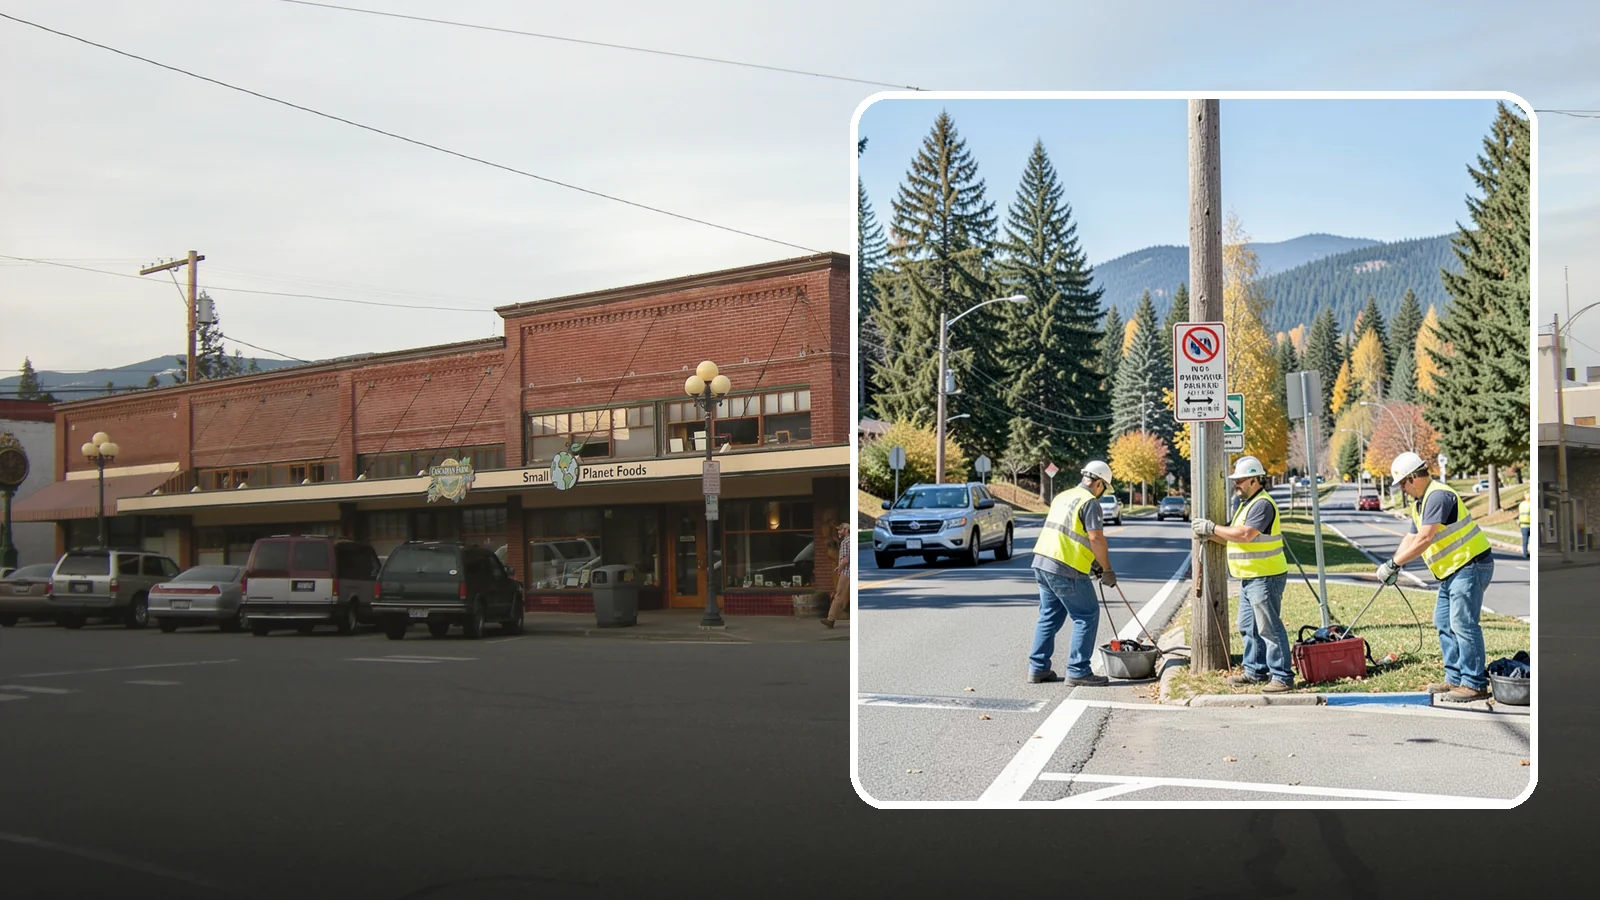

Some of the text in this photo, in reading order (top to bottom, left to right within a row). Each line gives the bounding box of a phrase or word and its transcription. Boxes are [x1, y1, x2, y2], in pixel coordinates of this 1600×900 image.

[523, 464, 647, 483] Small Planet Foods
